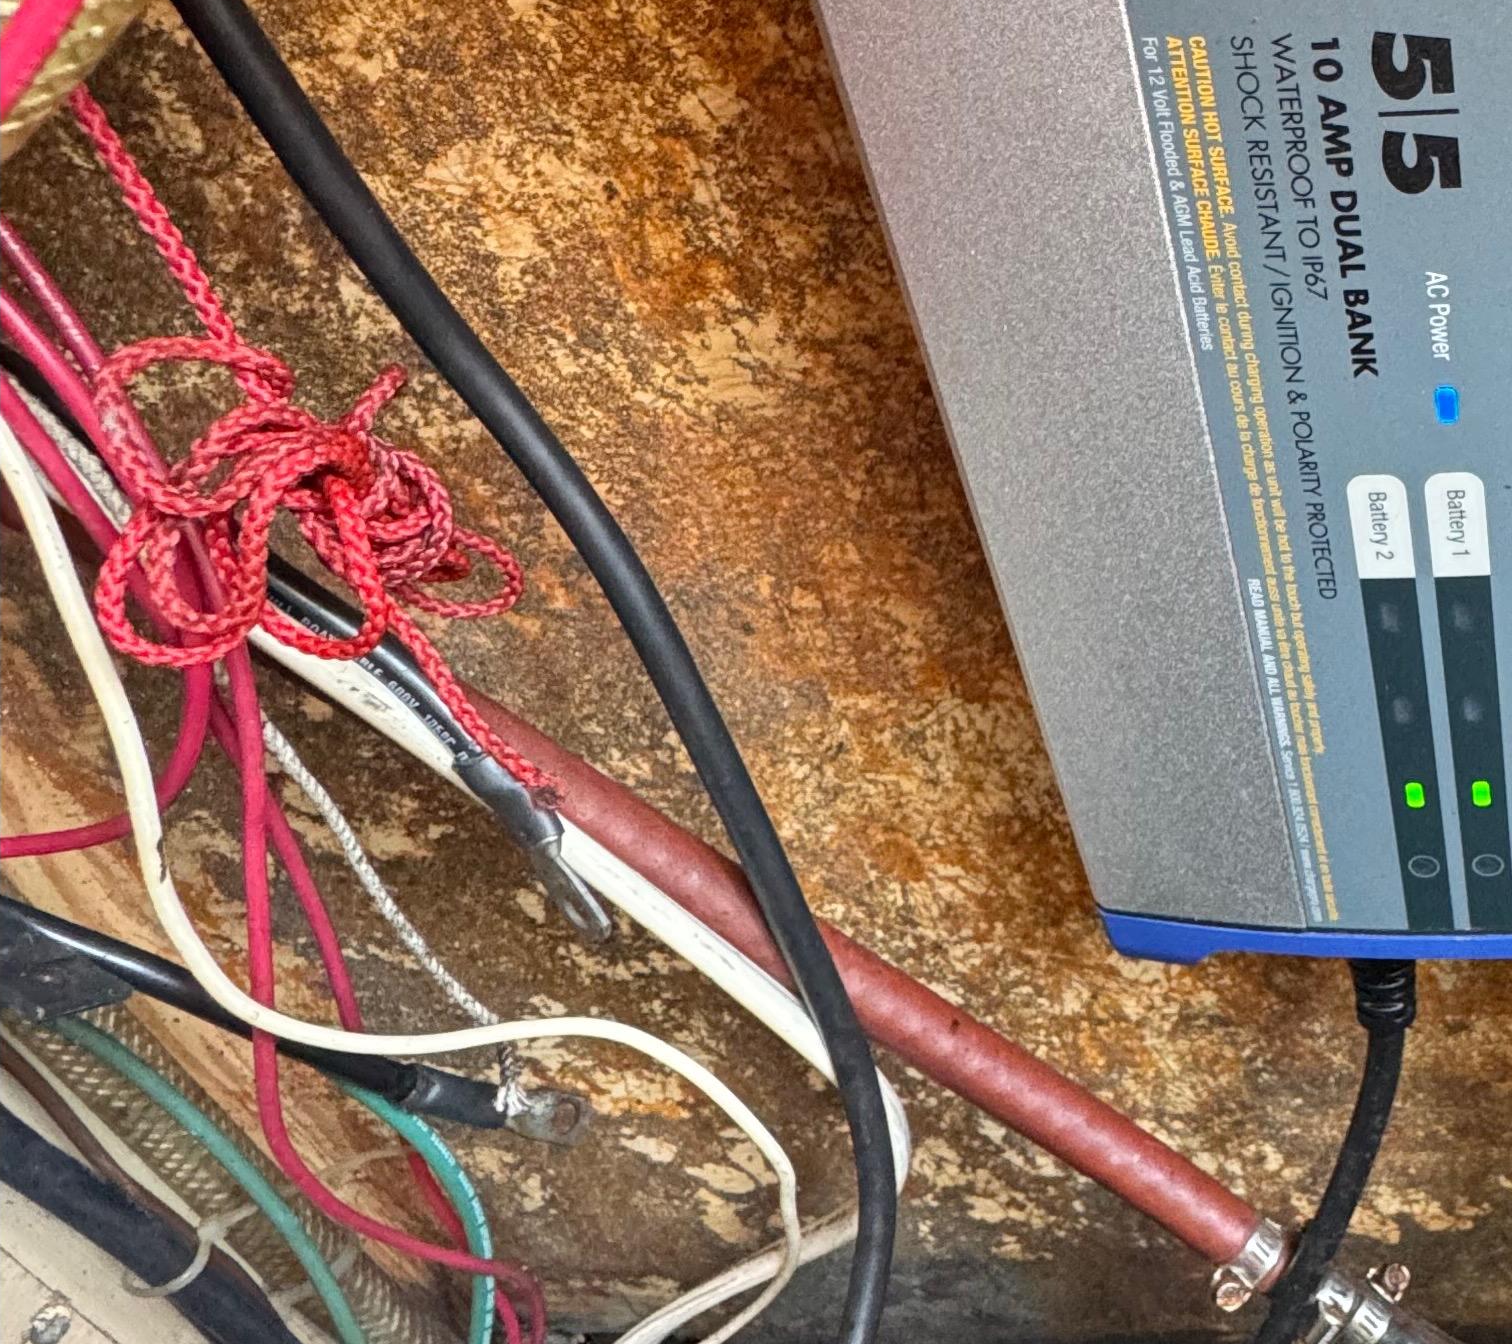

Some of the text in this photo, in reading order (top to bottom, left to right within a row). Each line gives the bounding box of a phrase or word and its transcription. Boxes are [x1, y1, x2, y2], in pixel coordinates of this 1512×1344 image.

[1163, 34, 1197, 126] ATTENTION
[1186, 35, 1217, 109] CAUTION
[1227, 33, 1268, 132] SHOCK
[1199, 110, 1222, 142] HOT
[1180, 127, 1210, 198] SURFACE
[1267, 31, 1329, 302] WATERPROOF TO IP67
[1139, 36, 1216, 351] For 12 Volt Flooded & AGM Lead Acid Batteries
[1205, 145, 1235, 219] SURFACE.
[1307, 36, 1380, 378] 10 AMP DUAL BANK
[1194, 199, 1222, 262] CHAUDE.
[1219, 221, 1242, 258] Avoid
[1206, 263, 1232, 300] Éviter
[1226, 260, 1250, 307] contact
[1213, 301, 1231, 315] le
[1423, 269, 1455, 362] AC Power
[1215, 315, 1239, 360] contact
[1231, 310, 1258, 351] during
[1224, 361, 1243, 378] au
[1239, 351, 1267, 404] charging
[1227, 379, 1249, 412] cours
[1284, 388, 1309, 405] &
[1233, 413, 1252, 429] de
[1236, 430, 1254, 442] la
[1248, 405, 1276, 457] operation
[1236, 442, 1261, 481] charge
[1261, 460, 1279, 474] as
[1288, 410, 1323, 498] POLARITY
[1246, 481, 1264, 497] de
[1264, 475, 1283, 496] unit
[1268, 498, 1286, 517] will
[1271, 518, 1289, 533] be
[1362, 490, 1394, 560] Battery 2
[1441, 488, 1469, 544] Battery
[1249, 497, 1278, 576] fonctionnement
[1274, 534, 1292, 552] hot
[1303, 501, 1339, 600] PROTECTED
[1278, 553, 1294, 564] to
[1280, 565, 1297, 582] the
[1246, 577, 1265, 607] READ
[1283, 582, 1302, 611] touch
[1252, 608, 1273, 651] MANUAL
[1288, 611, 1305, 627] but
[1260, 653, 1278, 675] AND
[1265, 676, 1281, 695] ALL
